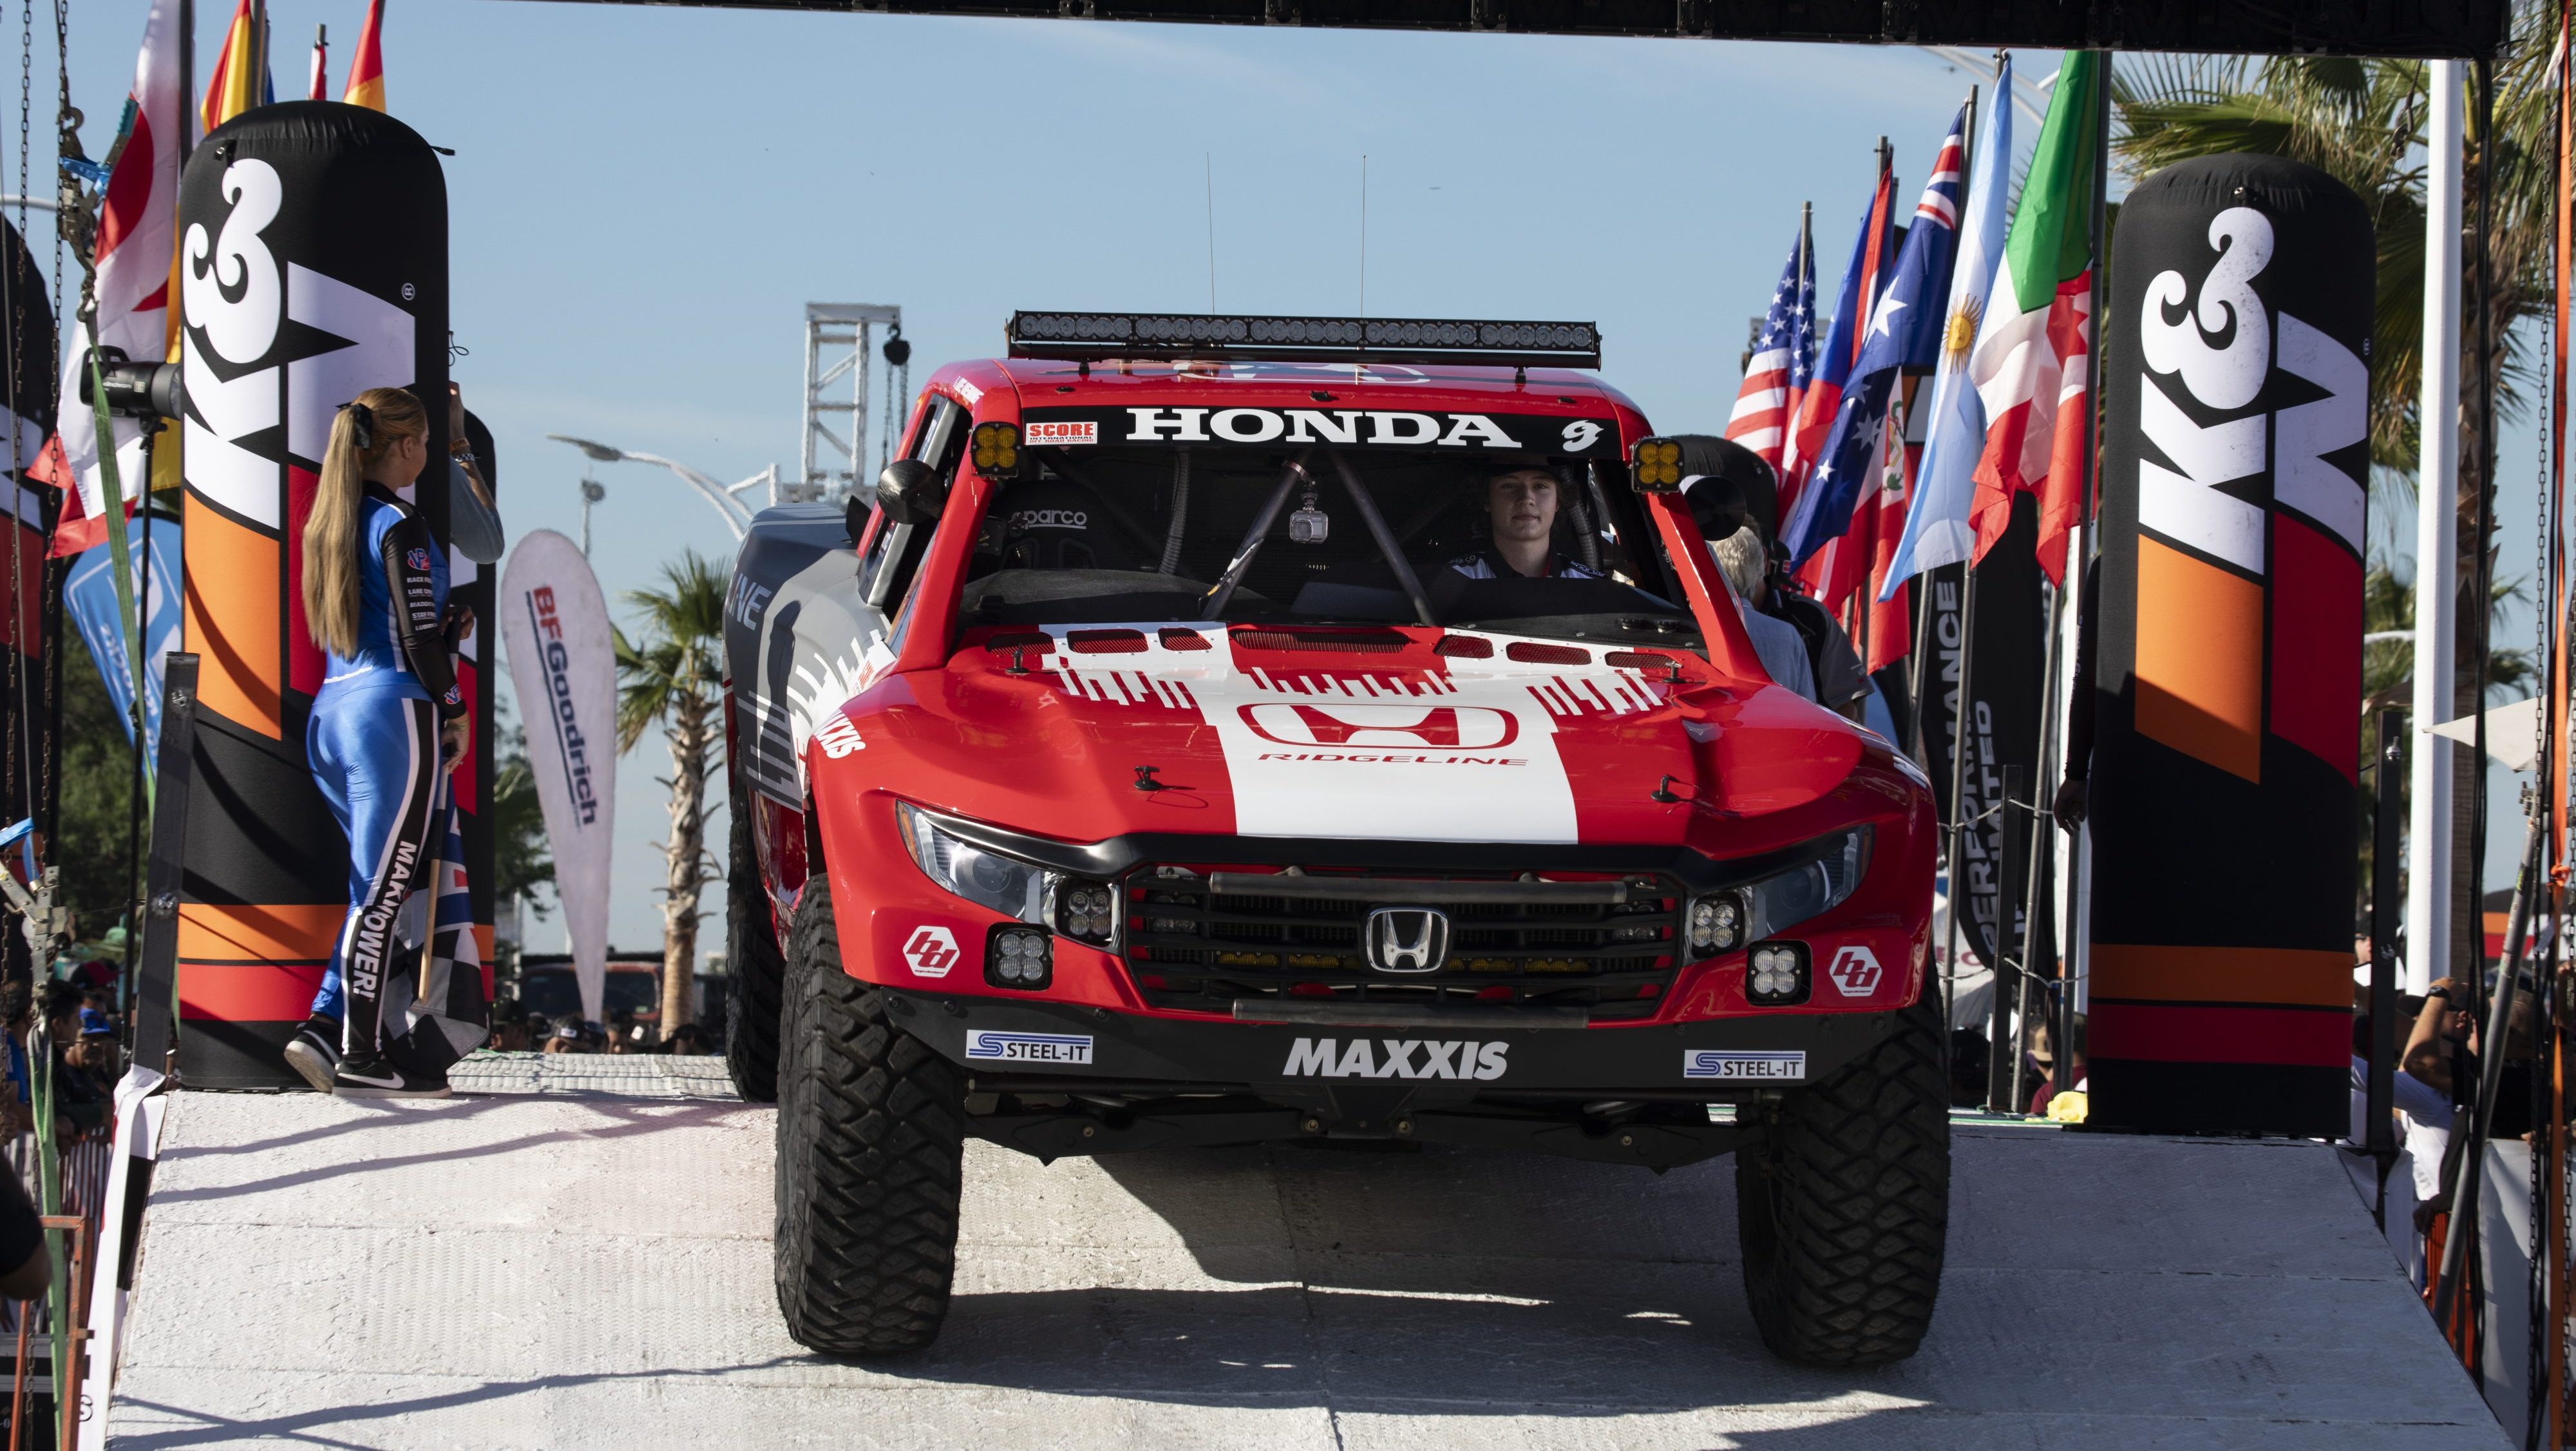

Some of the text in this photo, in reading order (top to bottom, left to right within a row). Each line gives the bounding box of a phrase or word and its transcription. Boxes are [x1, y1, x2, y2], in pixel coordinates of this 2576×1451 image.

[2138, 207, 2369, 575] K&N
[1029, 424, 1094, 437] SCORE
[1126, 408, 1522, 448] HONDA
[533, 586, 598, 826] BFGoodrich
[1258, 754, 1530, 766] RIDGELINE
[1007, 1042, 1087, 1061] STEEL-IT
[1282, 1038, 1510, 1081] MAXXIS
[1723, 1060, 1800, 1076] STEEL-IT
